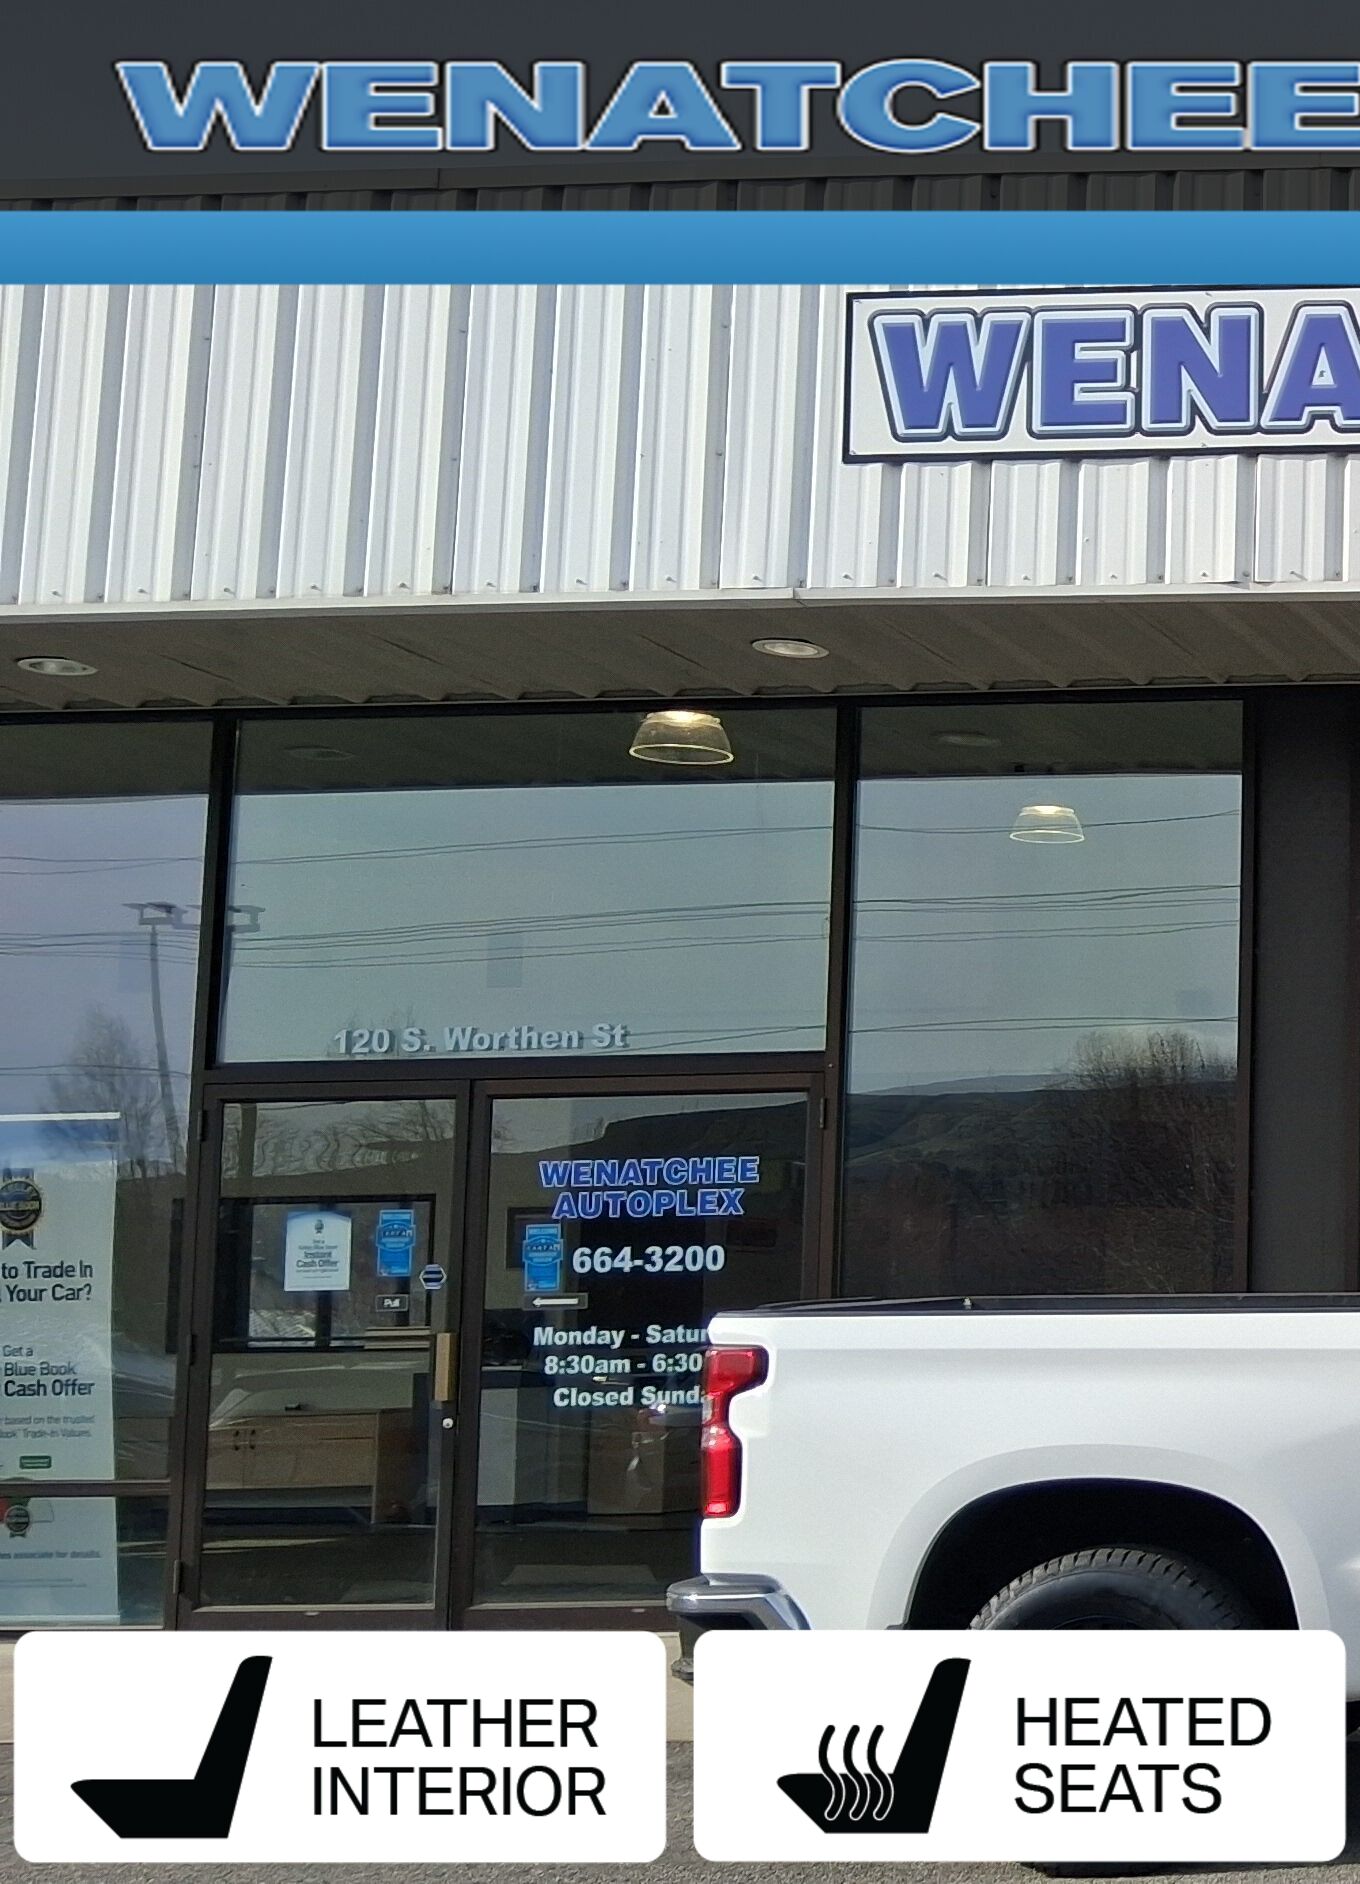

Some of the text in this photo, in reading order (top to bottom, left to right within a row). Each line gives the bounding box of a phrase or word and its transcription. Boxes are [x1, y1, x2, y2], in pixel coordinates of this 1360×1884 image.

[334, 1023, 628, 1054] 120 S. Worthen St
[539, 1155, 760, 1188] WENATCHEE
[552, 1187, 746, 1220] AUTOPLEX
[1, 1260, 94, 1279] to Trade In
[572, 1244, 725, 1274] 664-3200
[5, 1283, 92, 1302] Your Car?
[533, 1325, 626, 1350] Monday
[4, 1361, 77, 1377] Blue Book
[544, 1355, 631, 1375] 8:30am
[652, 1353, 703, 1373] 6:30
[4, 1378, 95, 1397] Cash Offer
[553, 1386, 635, 1407] Closed
